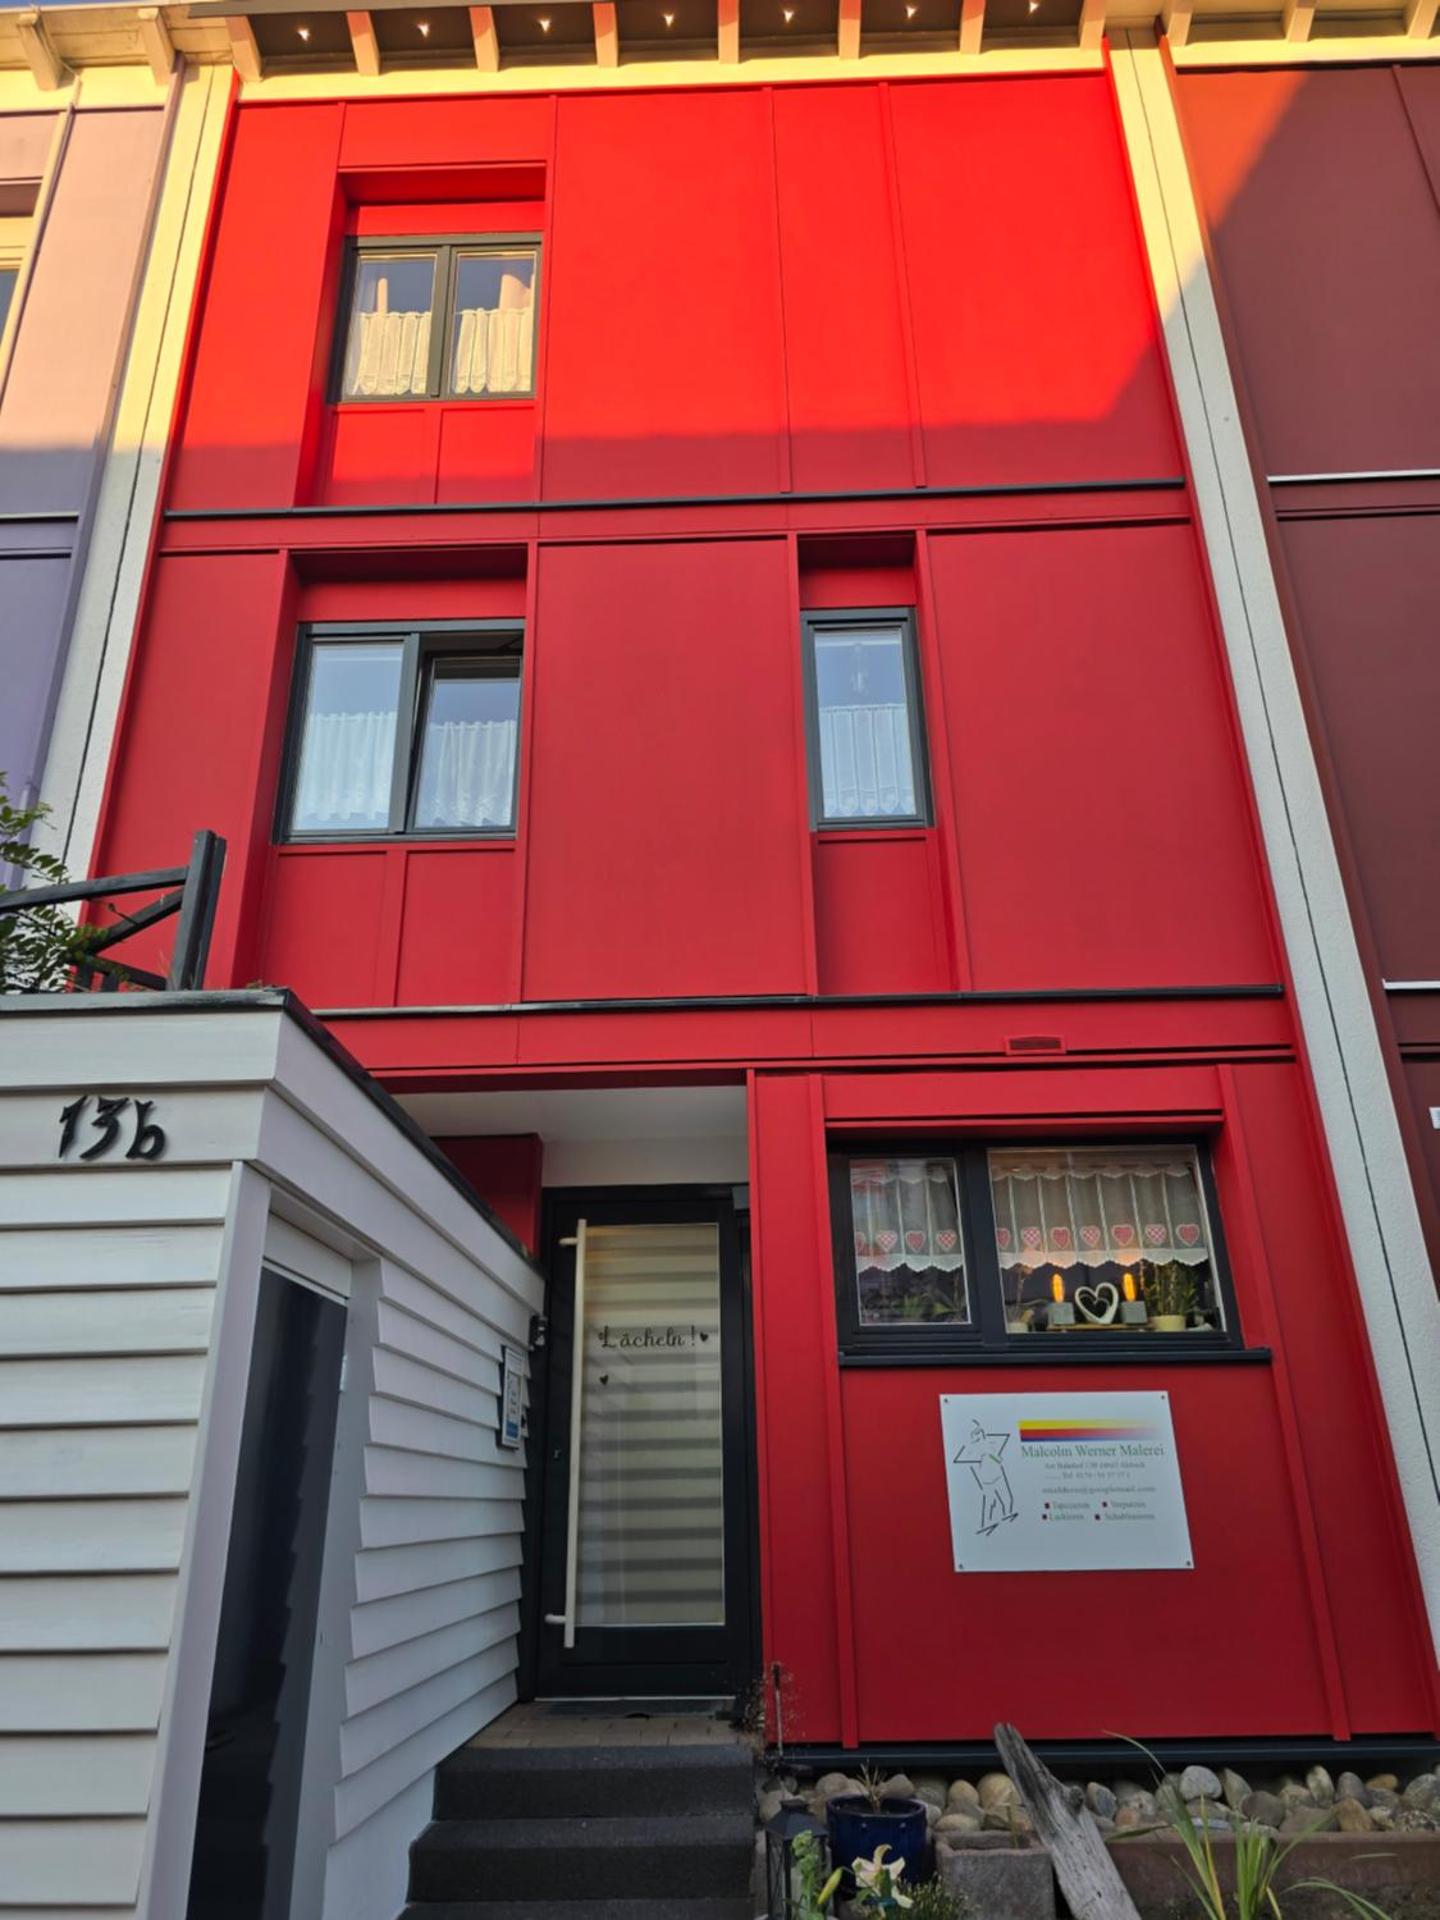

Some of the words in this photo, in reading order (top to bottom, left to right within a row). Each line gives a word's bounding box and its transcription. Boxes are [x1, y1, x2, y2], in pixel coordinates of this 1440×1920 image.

[59, 1095, 167, 1160] 13b
[1021, 1444, 1073, 1457] Malcolm
[1074, 1444, 1117, 1456] Werner
[1119, 1443, 1165, 1456] Malerei
